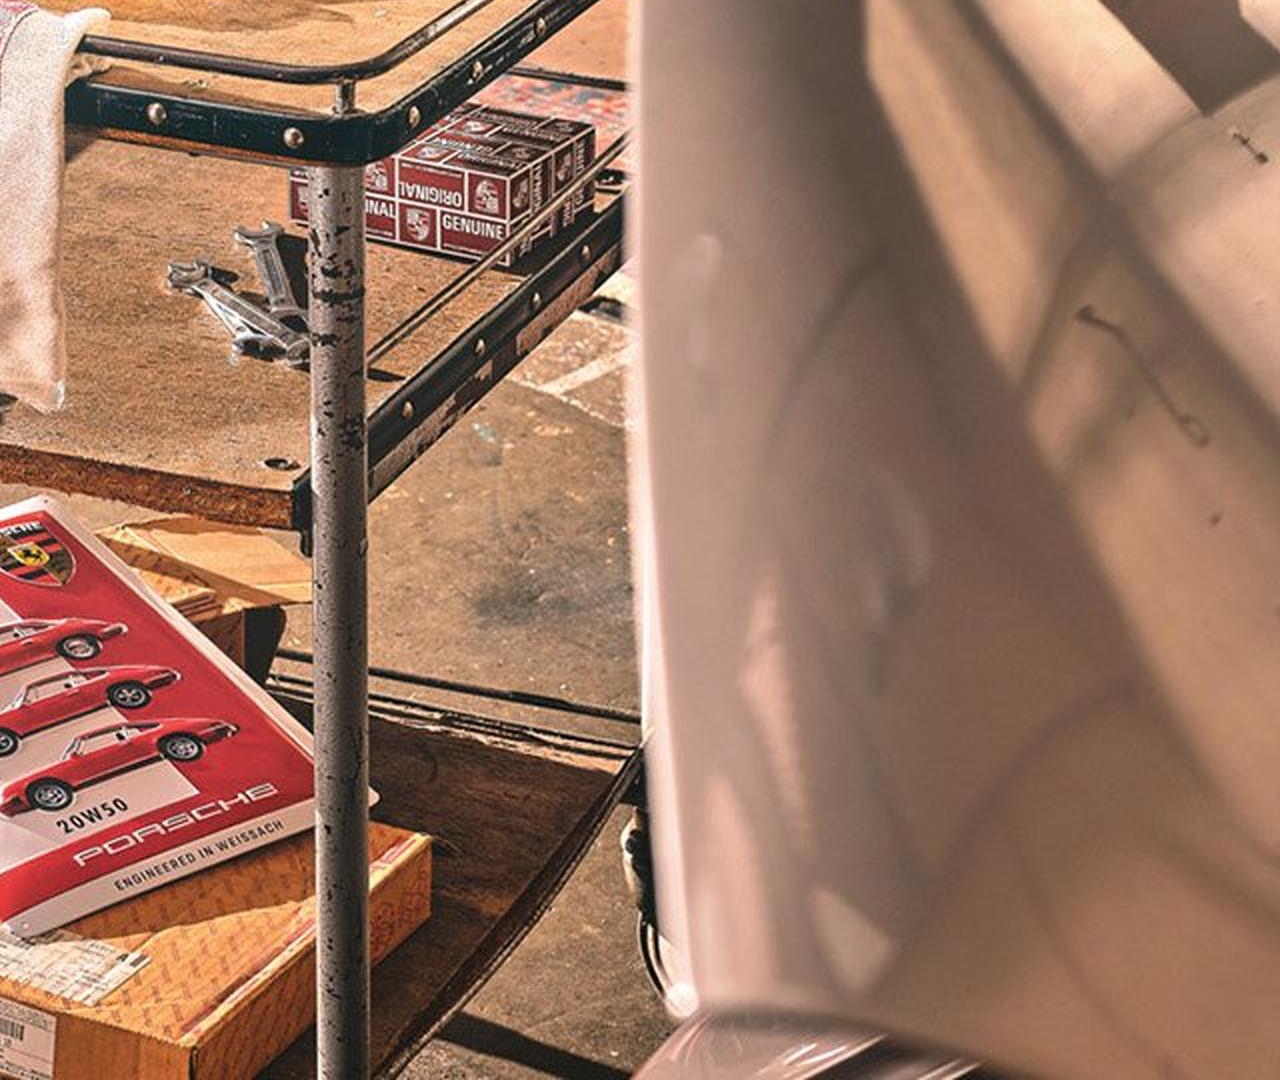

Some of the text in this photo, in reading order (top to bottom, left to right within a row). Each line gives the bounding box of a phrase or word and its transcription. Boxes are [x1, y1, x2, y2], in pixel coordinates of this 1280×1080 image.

[365, 198, 397, 219] INAL
[400, 180, 462, 208] ORIGINAL
[442, 214, 504, 239] GENUINE
[56, 797, 128, 835] 20W50
[73, 782, 279, 868] PORSCHE
[113, 819, 285, 892] ENGINEERED IN WEISSACH
